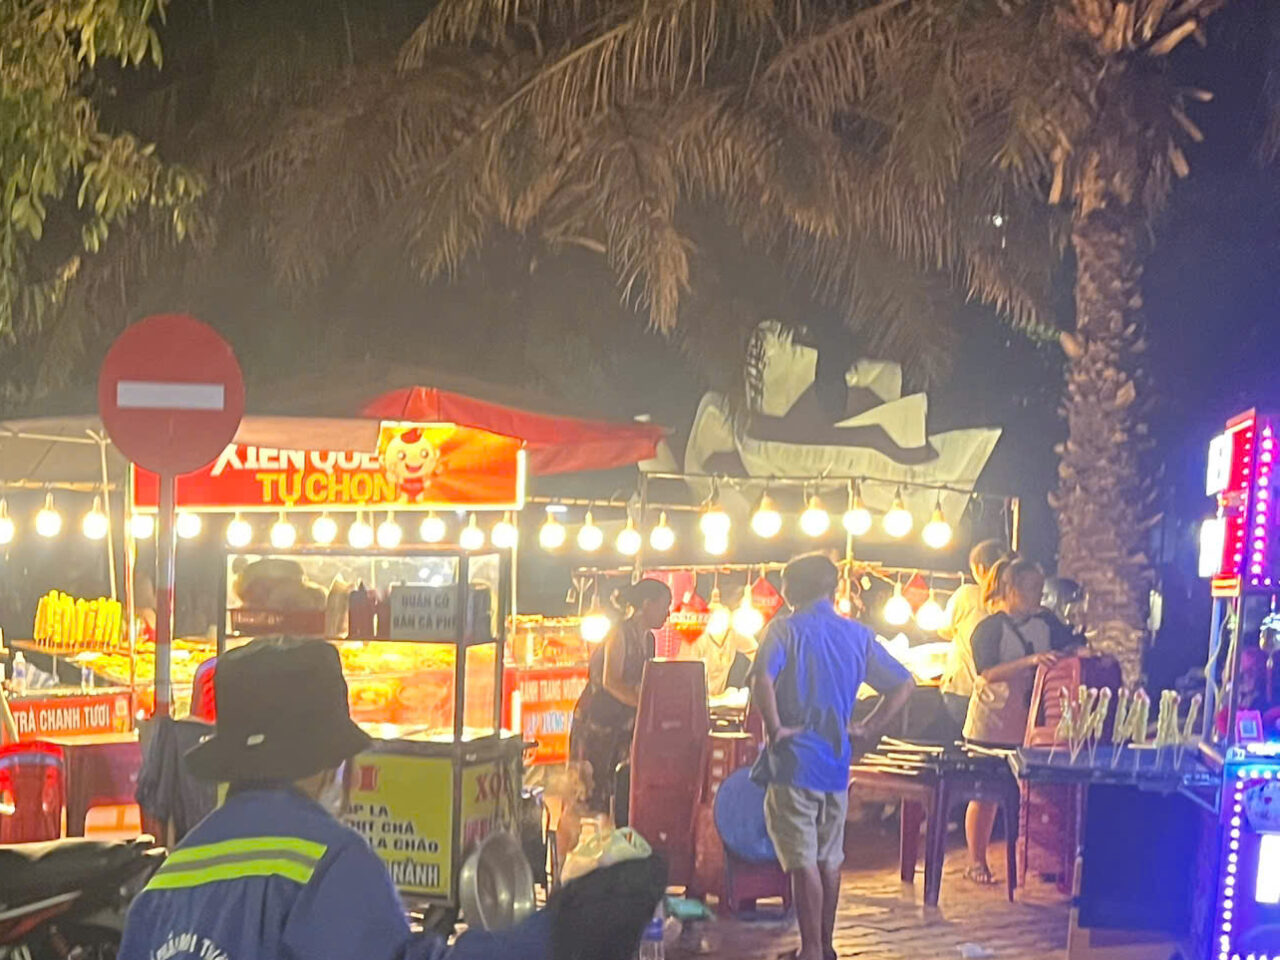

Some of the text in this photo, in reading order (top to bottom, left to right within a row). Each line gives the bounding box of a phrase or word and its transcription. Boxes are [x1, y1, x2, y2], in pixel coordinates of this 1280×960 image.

[13, 704, 111, 733] TRÀ CHANH TƯƠI
